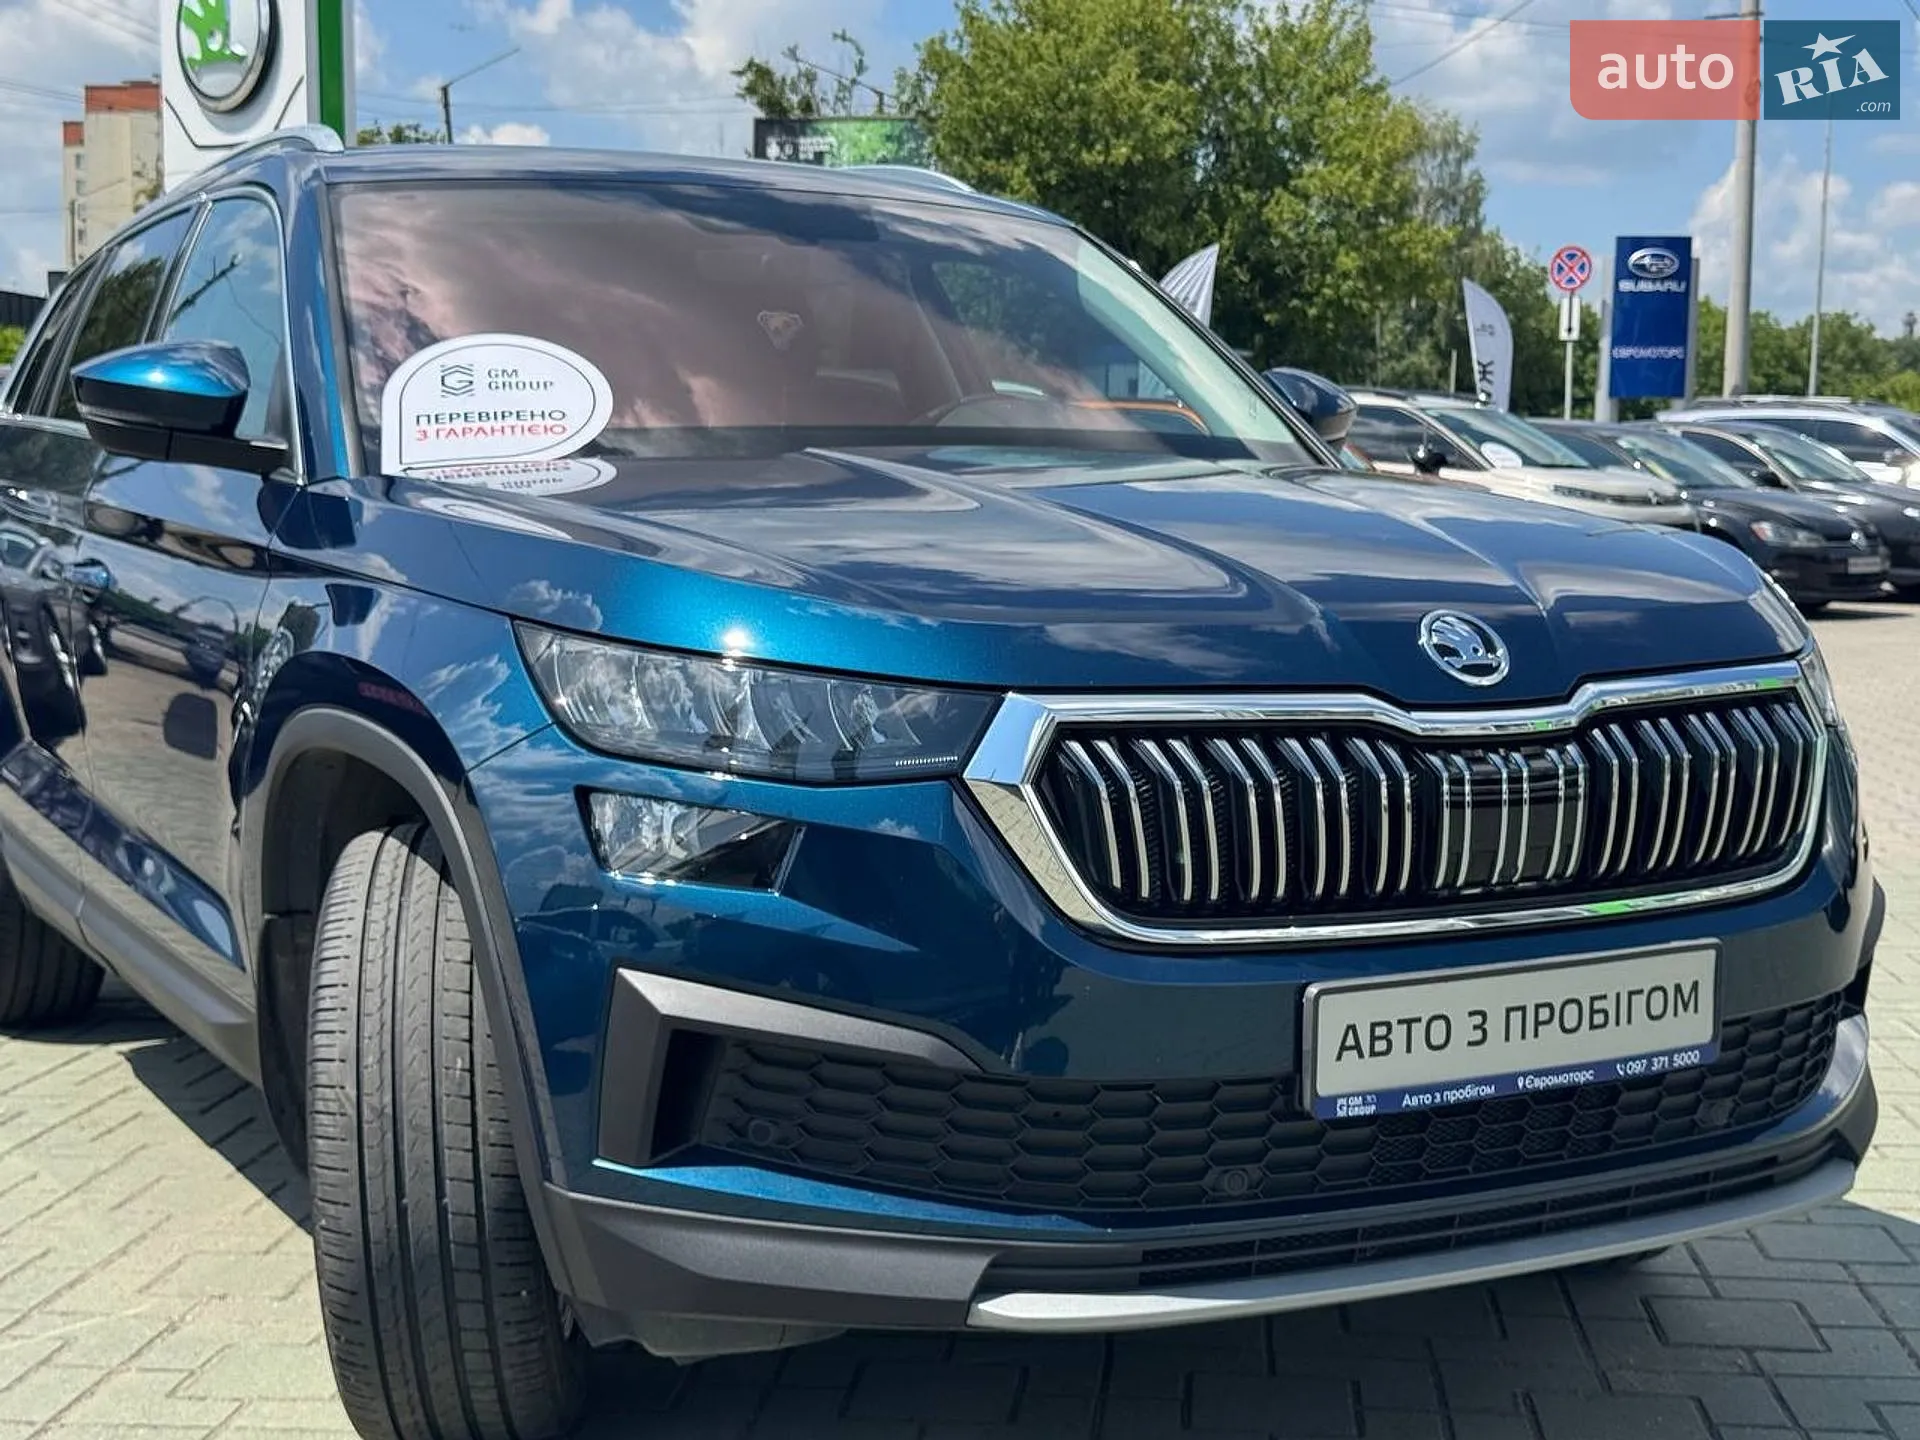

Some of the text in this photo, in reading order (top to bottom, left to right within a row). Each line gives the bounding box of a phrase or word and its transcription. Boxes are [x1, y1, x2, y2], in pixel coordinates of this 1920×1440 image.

[1618, 280, 1687, 293] SUBARU
[488, 368, 519, 379] GM
[488, 381, 554, 391] GROUP
[416, 410, 567, 426] ПЕРЕВІРЕНО
[436, 424, 567, 440] ГАРАНТІЄЮ
[1335, 1014, 1453, 1061] АВТО
[1504, 980, 1700, 1042] ПРОБІГОМ
[1626, 1050, 1700, 1074] 097 371 5000
[1525, 1070, 1595, 1090] Євромоторс
[1402, 1093, 1433, 1107] Авто
[1443, 1084, 1496, 1103] пробігом
